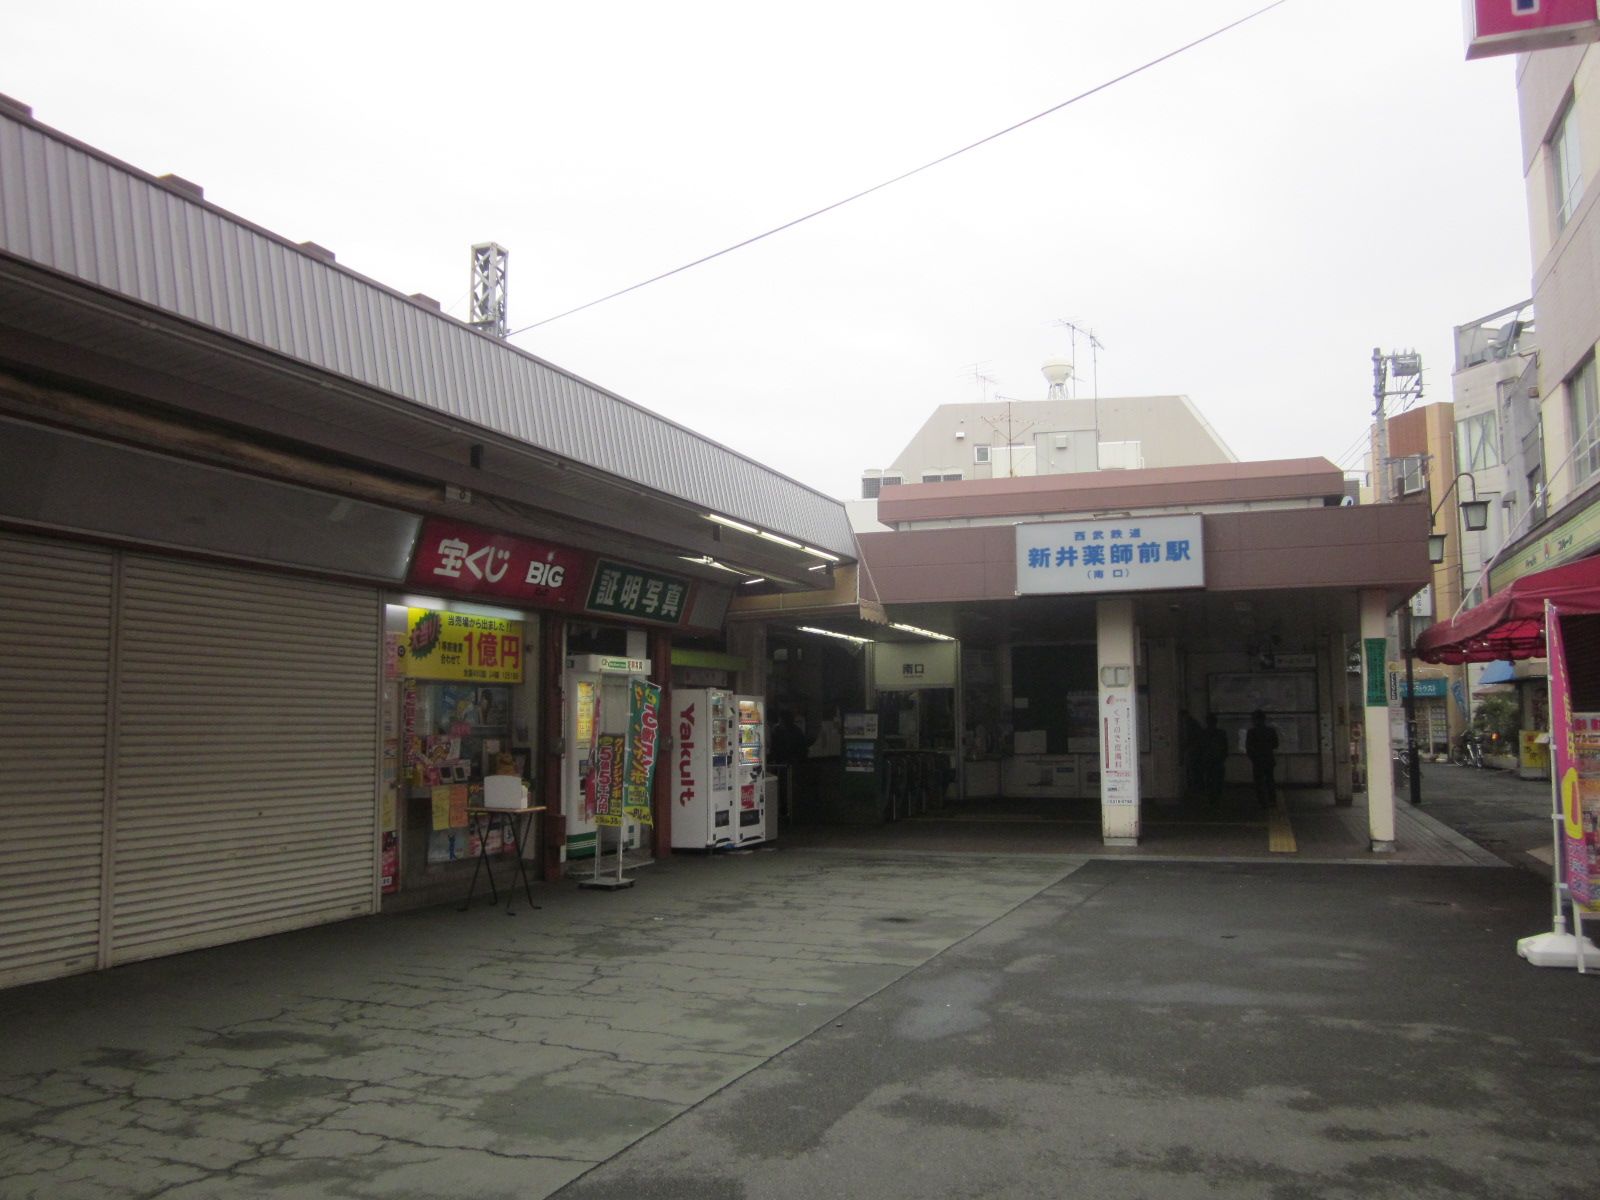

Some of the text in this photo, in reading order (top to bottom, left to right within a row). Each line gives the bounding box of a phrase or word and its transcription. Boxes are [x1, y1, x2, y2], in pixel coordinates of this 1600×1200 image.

[1073, 527, 1142, 542] 西武鉄道
[433, 538, 511, 584] 宝くじ
[1028, 540, 1191, 570] 新井薬師前駅
[526, 560, 566, 589] BIG
[596, 568, 684, 619] 証明写真
[464, 632, 519, 668] 1億円
[902, 663, 924, 675] 南口
[679, 702, 695, 807] Yakult
